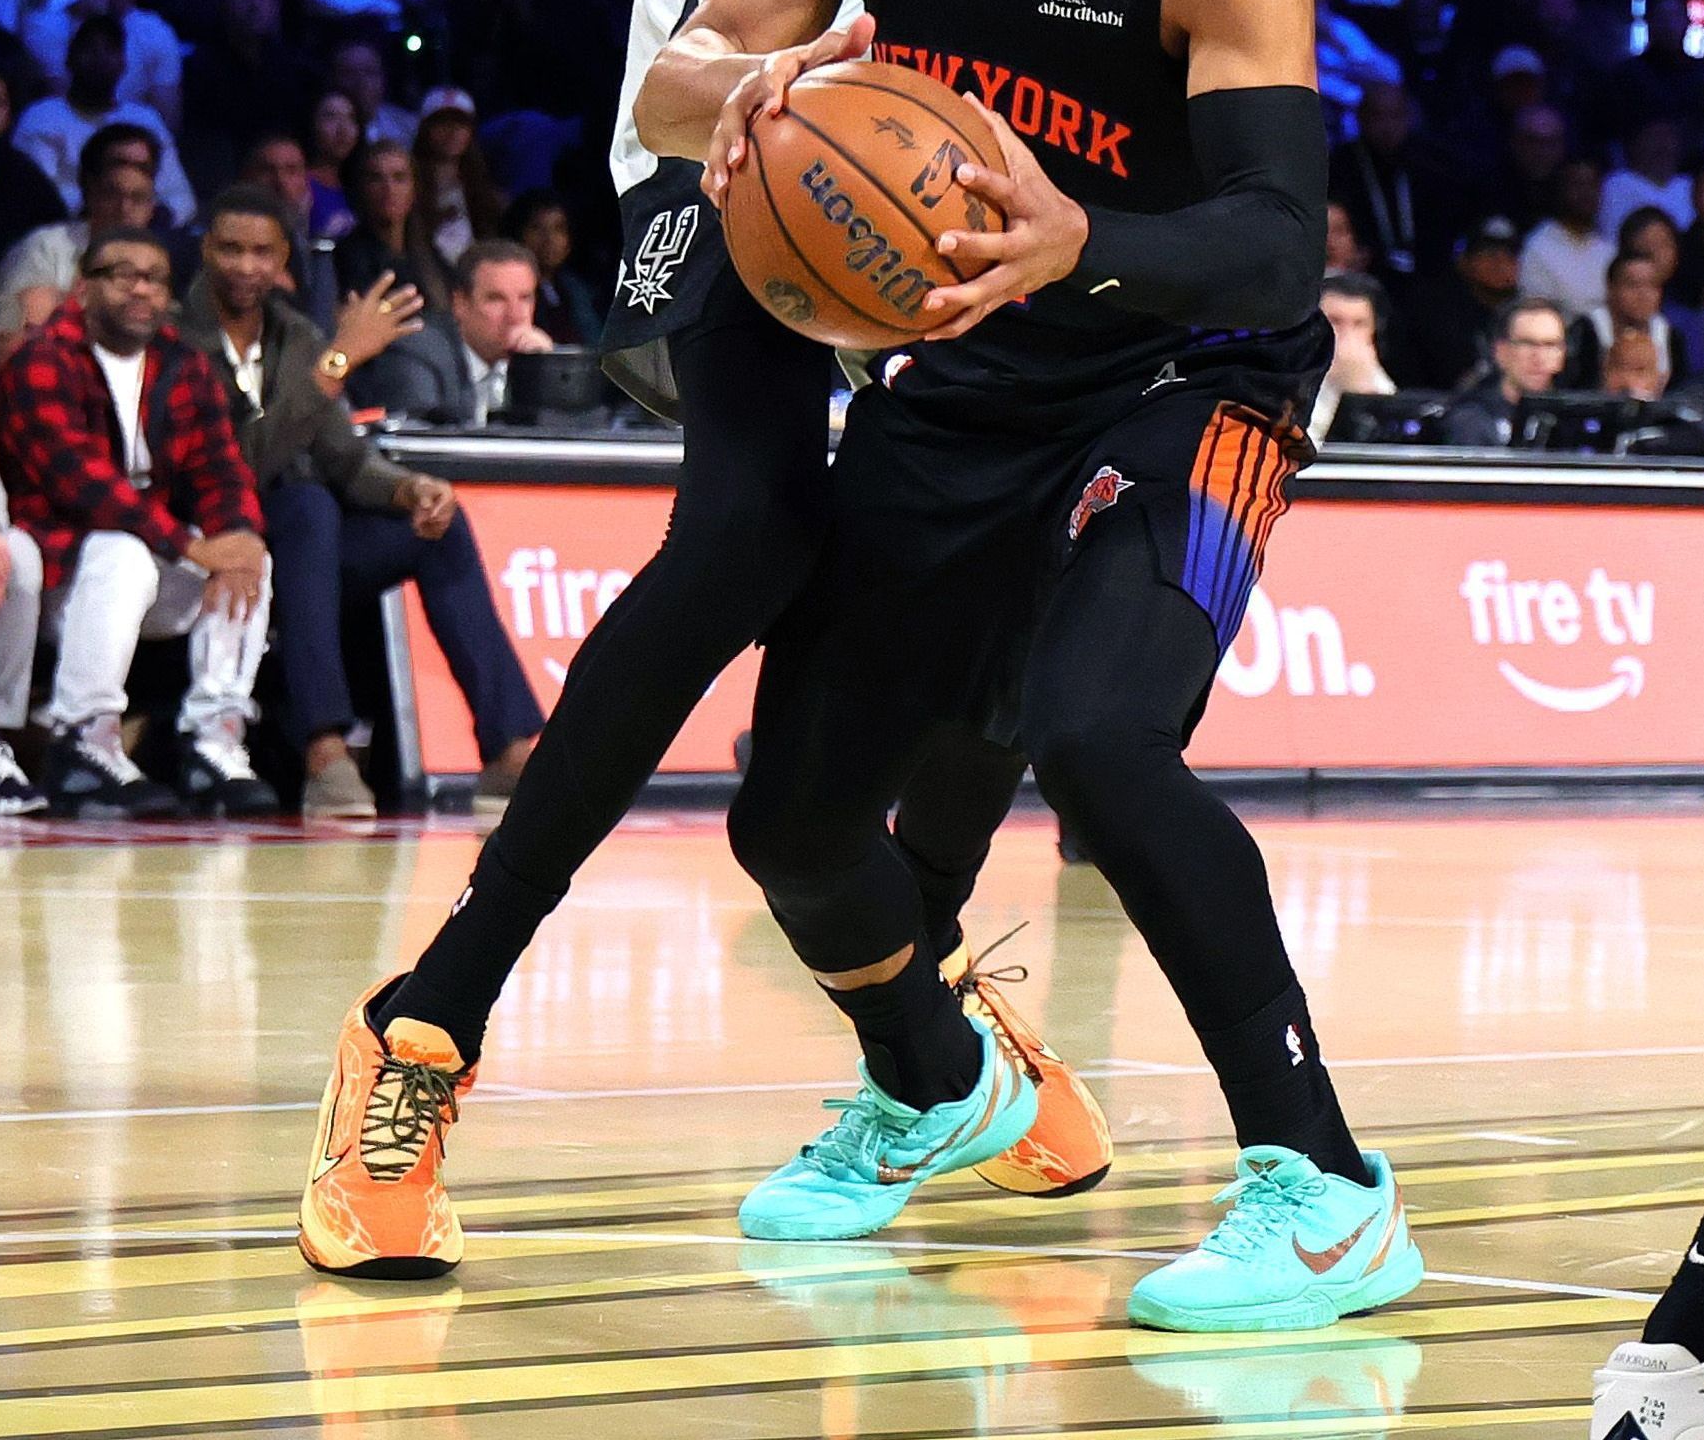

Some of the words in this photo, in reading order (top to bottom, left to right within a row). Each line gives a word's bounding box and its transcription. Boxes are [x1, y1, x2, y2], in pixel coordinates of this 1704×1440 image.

[1037, 1, 1072, 18] abu
[1074, 6, 1124, 28] dhabi
[971, 60, 1133, 179] YORK
[799, 159, 937, 320] Wilson
[1216, 584, 1376, 698] On.
[1459, 560, 1582, 646] fire
[1586, 567, 1655, 646] tv
